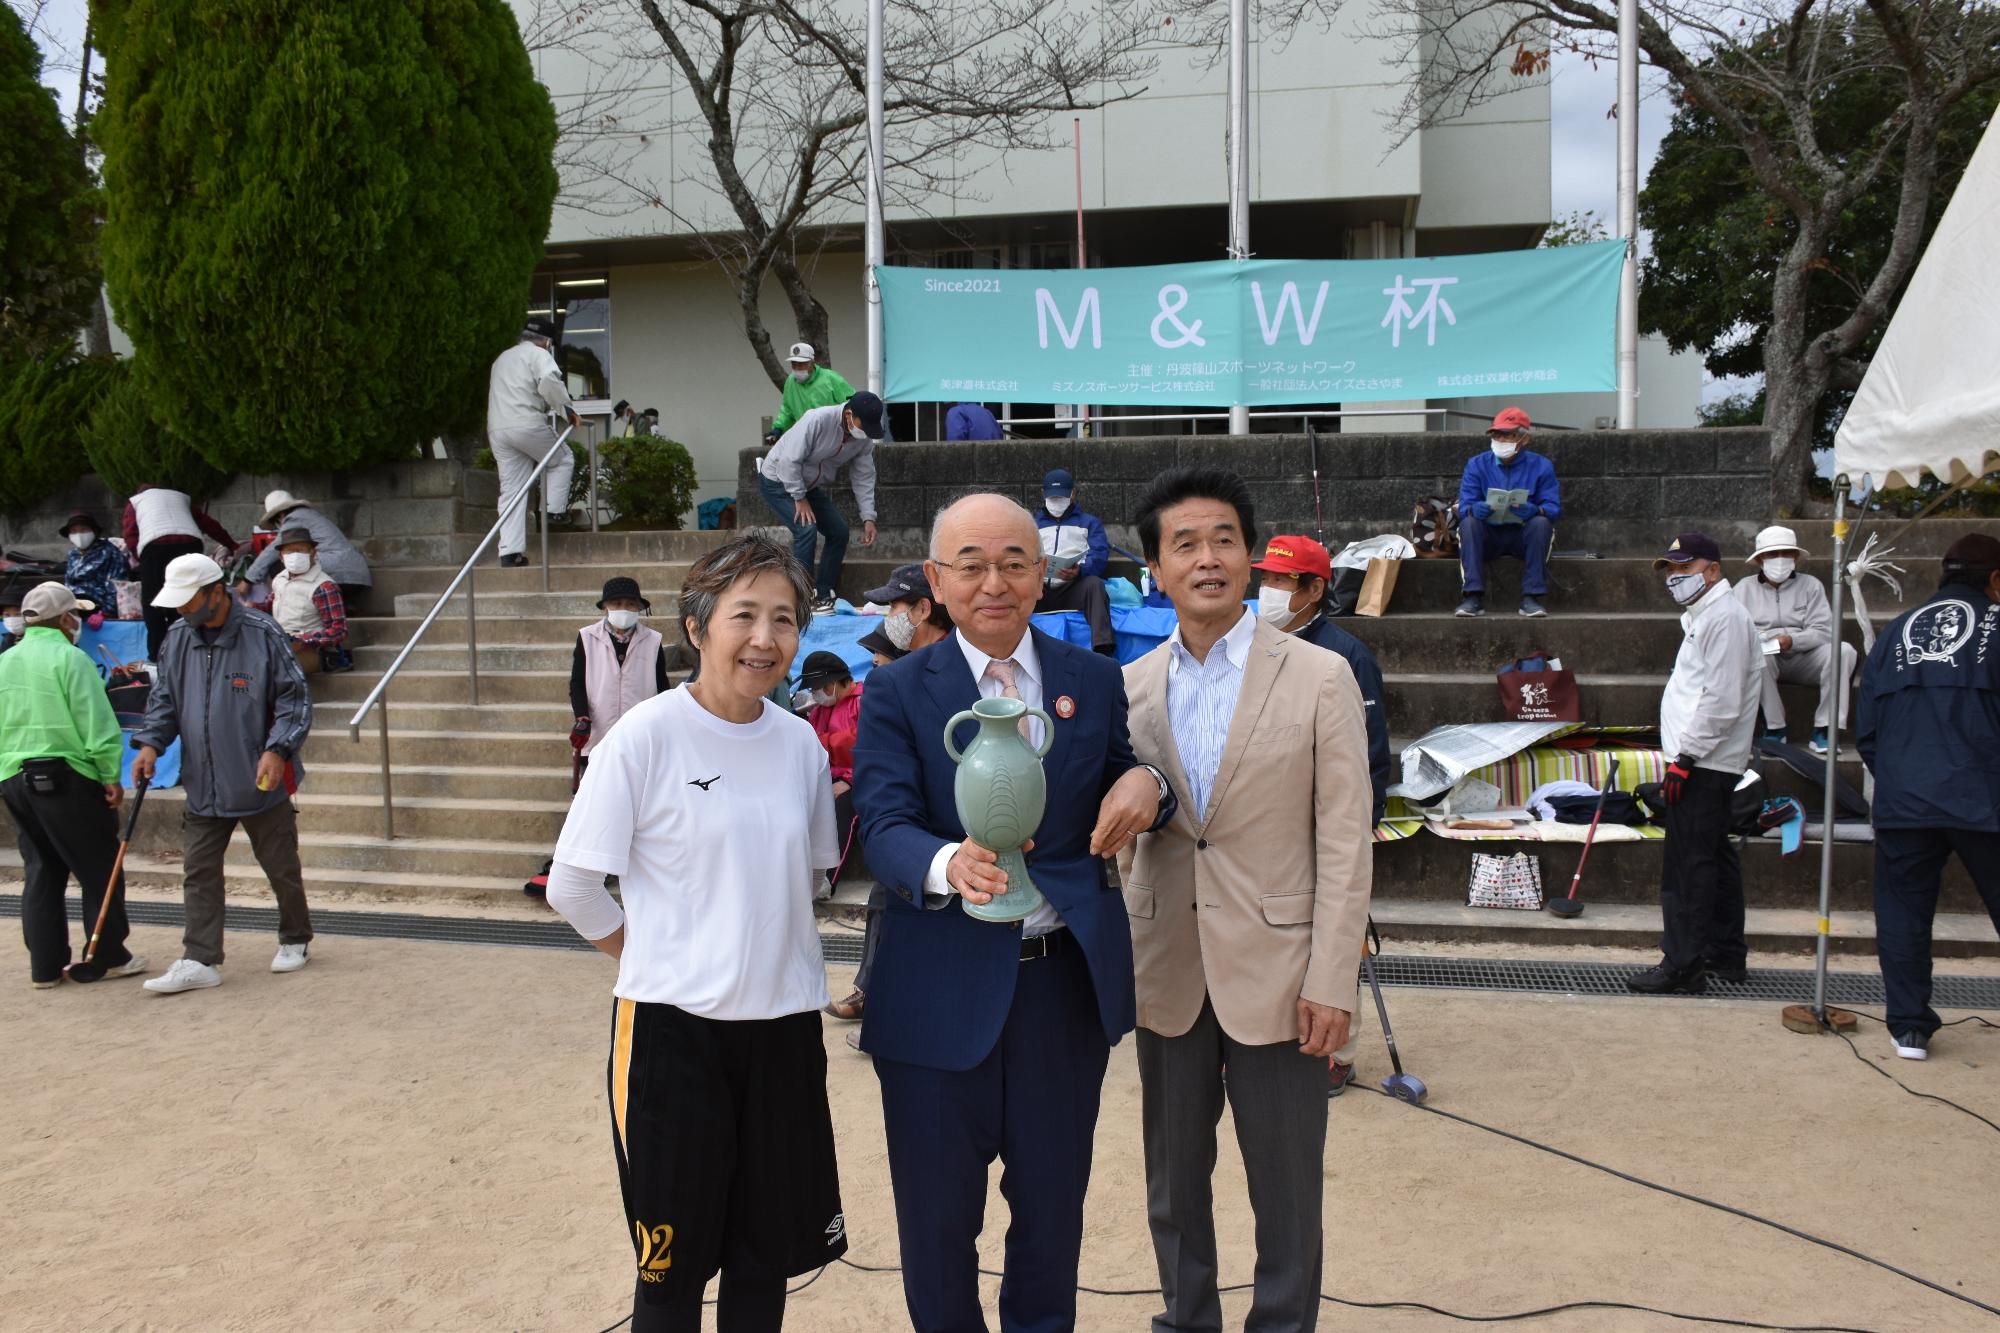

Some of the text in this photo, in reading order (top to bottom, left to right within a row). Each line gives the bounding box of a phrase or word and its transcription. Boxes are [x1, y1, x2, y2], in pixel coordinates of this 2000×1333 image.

[924, 278, 1001, 293] Since2021
[1035, 274, 1459, 349] M & W 杯
[1052, 380, 1216, 393] ミズノスポーツサービス株式会社
